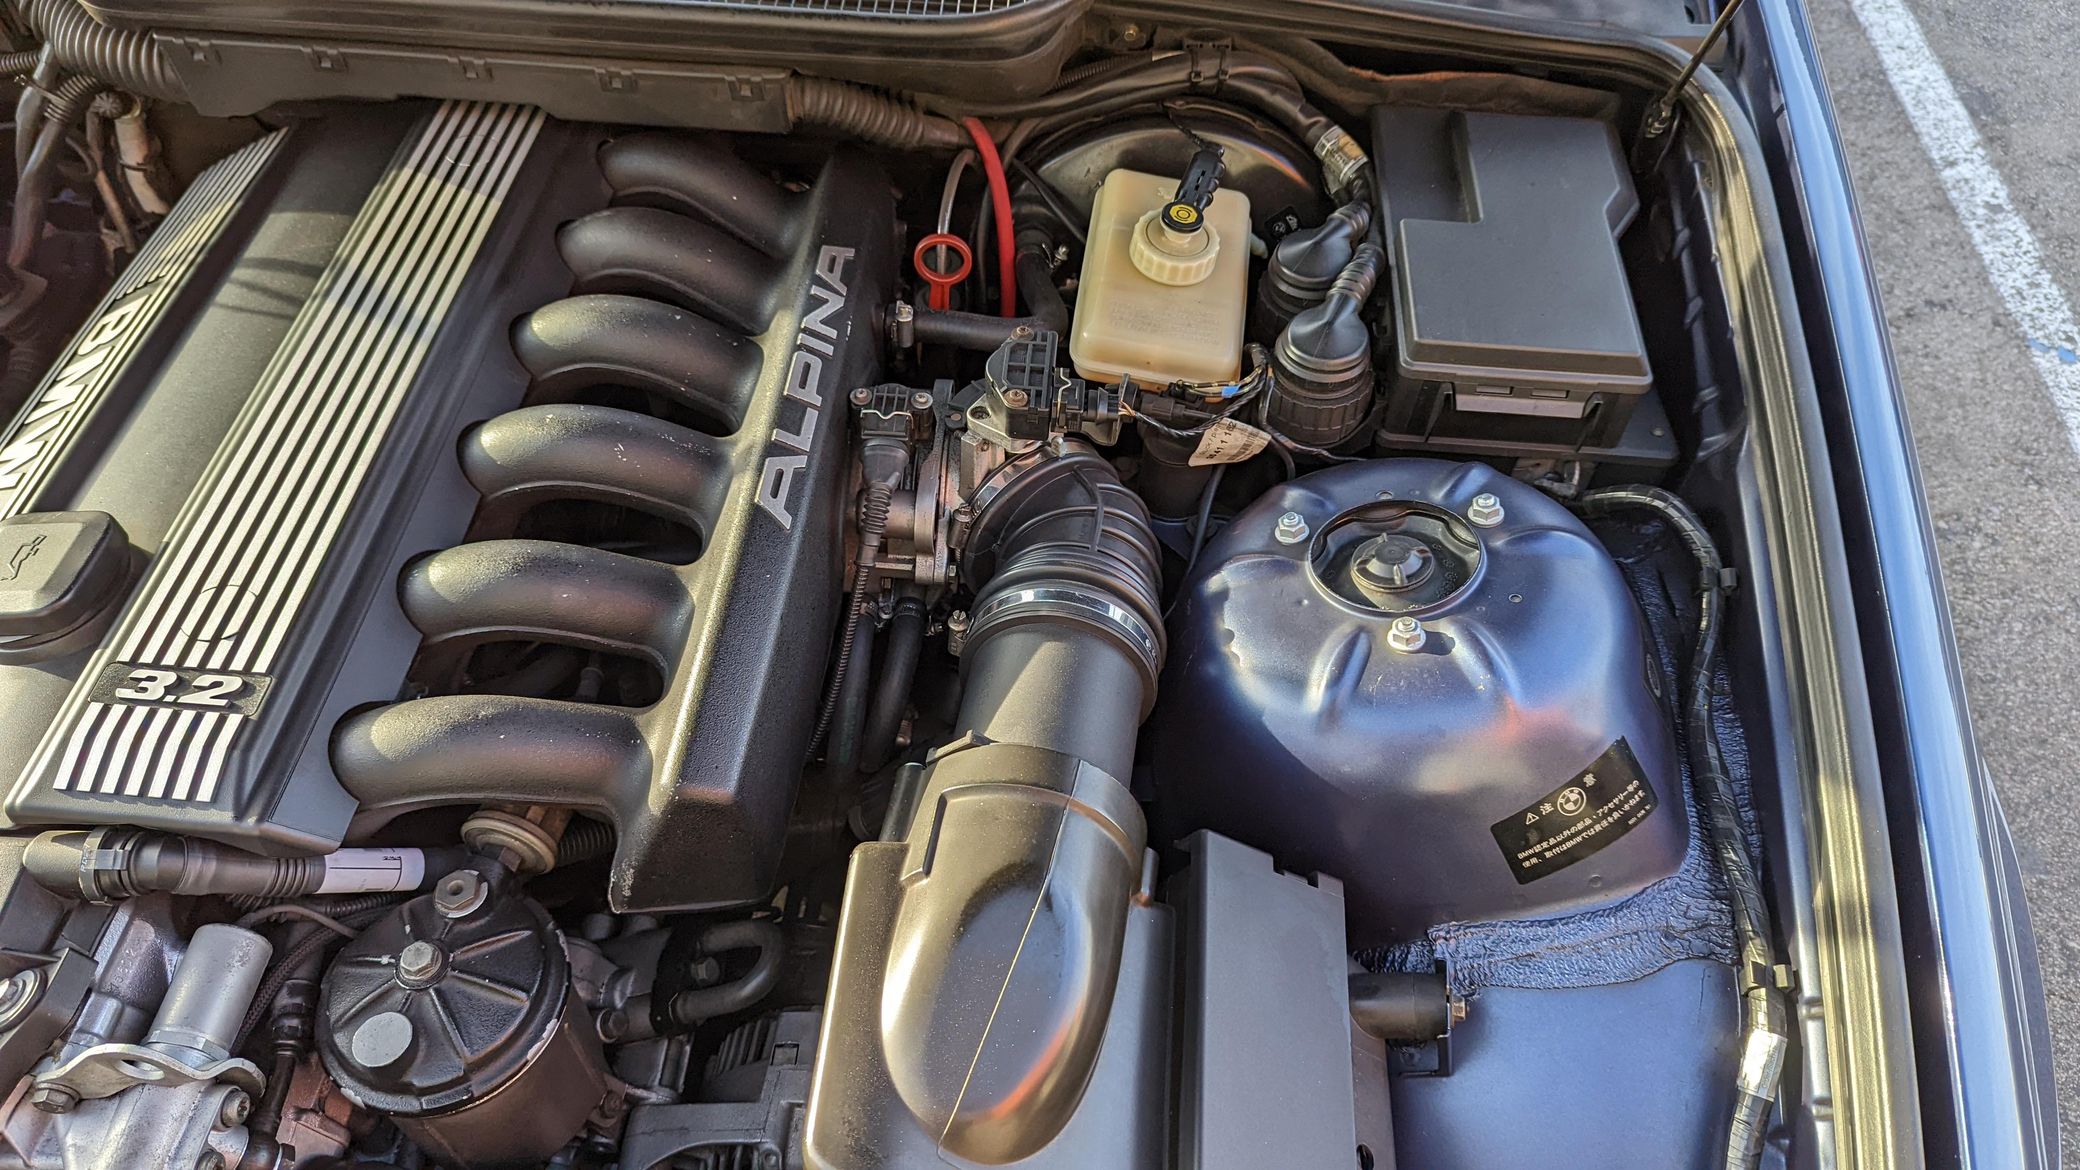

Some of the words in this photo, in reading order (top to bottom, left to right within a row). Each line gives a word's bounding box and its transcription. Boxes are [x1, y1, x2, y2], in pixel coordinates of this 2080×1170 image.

[0, 294, 151, 491] BMW
[755, 245, 855, 531] ALPINA
[115, 669, 243, 706] 3.2
